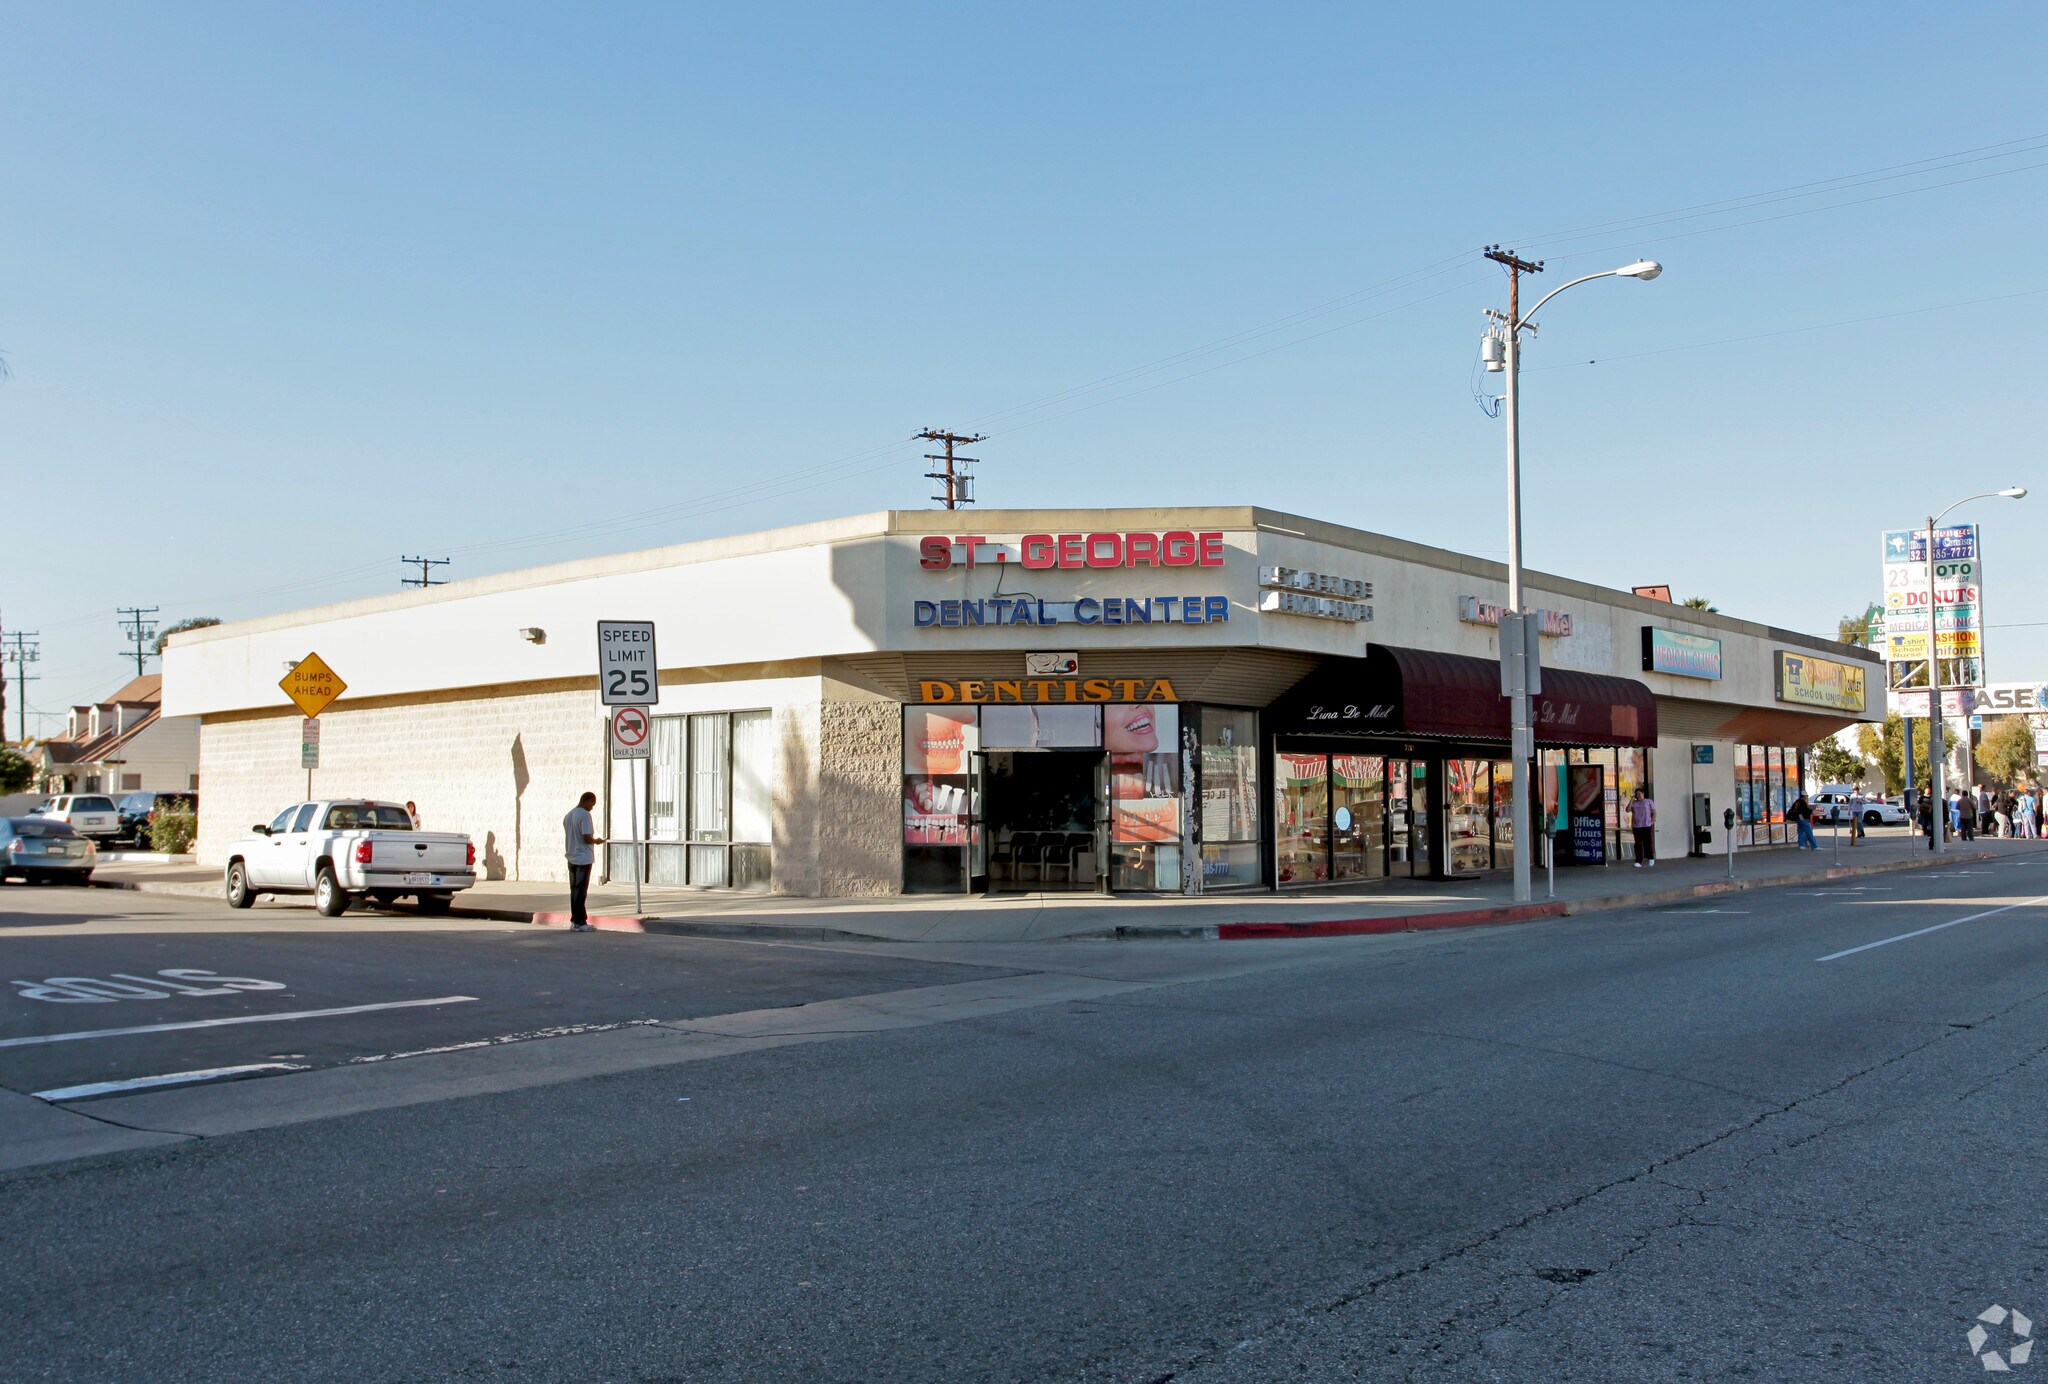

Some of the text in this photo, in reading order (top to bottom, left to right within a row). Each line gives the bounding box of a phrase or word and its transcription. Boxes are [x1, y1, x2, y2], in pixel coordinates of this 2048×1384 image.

[1020, 531, 1226, 570] GEORGE
[1888, 569, 1909, 588] 23
[1906, 587, 1976, 606] DONUTS
[913, 596, 1230, 627] DENTAL CENTER
[1889, 620, 1929, 631] MEDICA
[1939, 617, 1975, 628] CLINIC
[603, 630, 650, 643] SPEED
[1936, 631, 1976, 642] ASHION
[608, 650, 645, 662] LIMIT
[1655, 645, 1720, 673] MEDICAL CLINIC
[294, 671, 332, 683] BUMPS
[607, 669, 650, 696] 25
[293, 686, 331, 696] AHEAD
[918, 678, 1180, 703] DENTISTA
[1794, 687, 1824, 700] SCHOOL
[1974, 688, 2033, 710] ASE
[1306, 704, 1395, 720] Luna De Miel
[1541, 701, 1555, 723] De
[1558, 703, 1580, 725] Miel
[630, 747, 634, 757] 3
[1573, 816, 1601, 828] Office
[1574, 828, 1602, 838] Hours
[1203, 862, 1229, 875] 585-7777
[11, 968, 286, 1003] STOP
